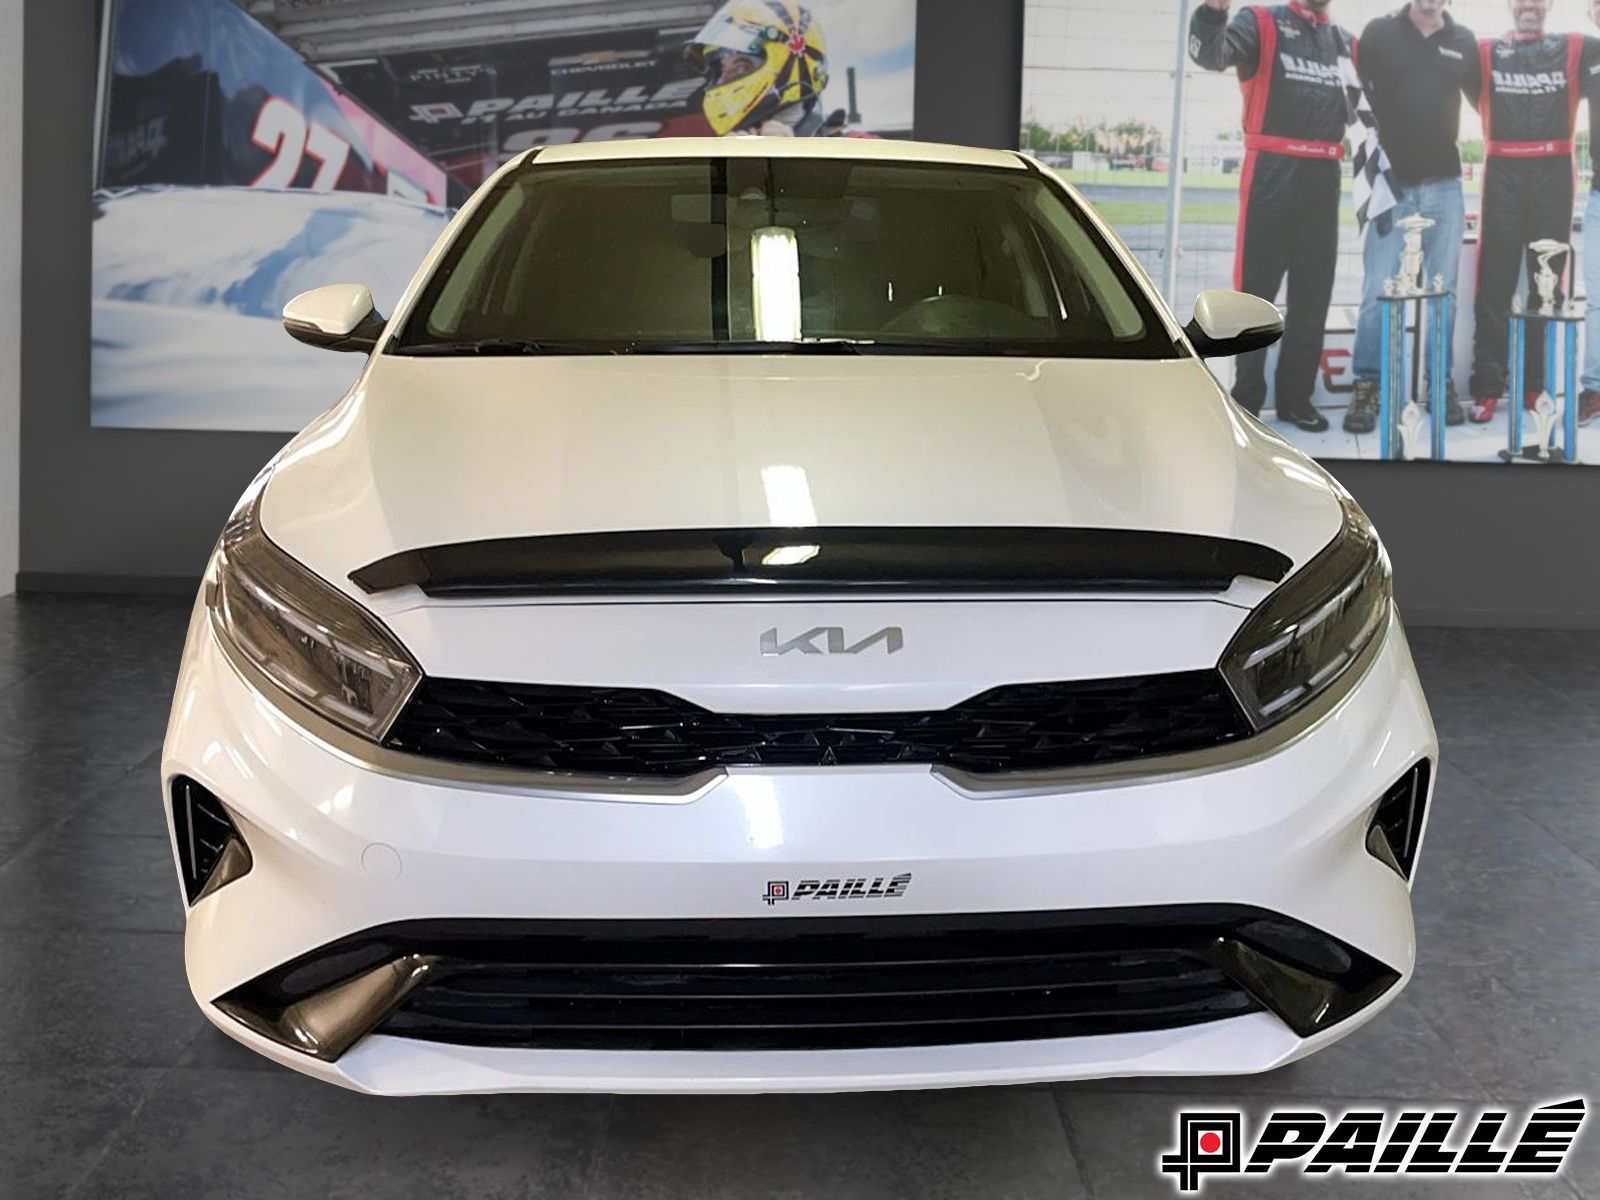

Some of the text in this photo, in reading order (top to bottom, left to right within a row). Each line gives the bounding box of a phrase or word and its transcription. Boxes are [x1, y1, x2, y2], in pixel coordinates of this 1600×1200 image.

[550, 60, 658, 75] CHEVROLET
[505, 110, 546, 121] AU
[557, 100, 687, 117] CANADA
[760, 627, 904, 655] KIA
[791, 872, 912, 900] PAILLÉ
